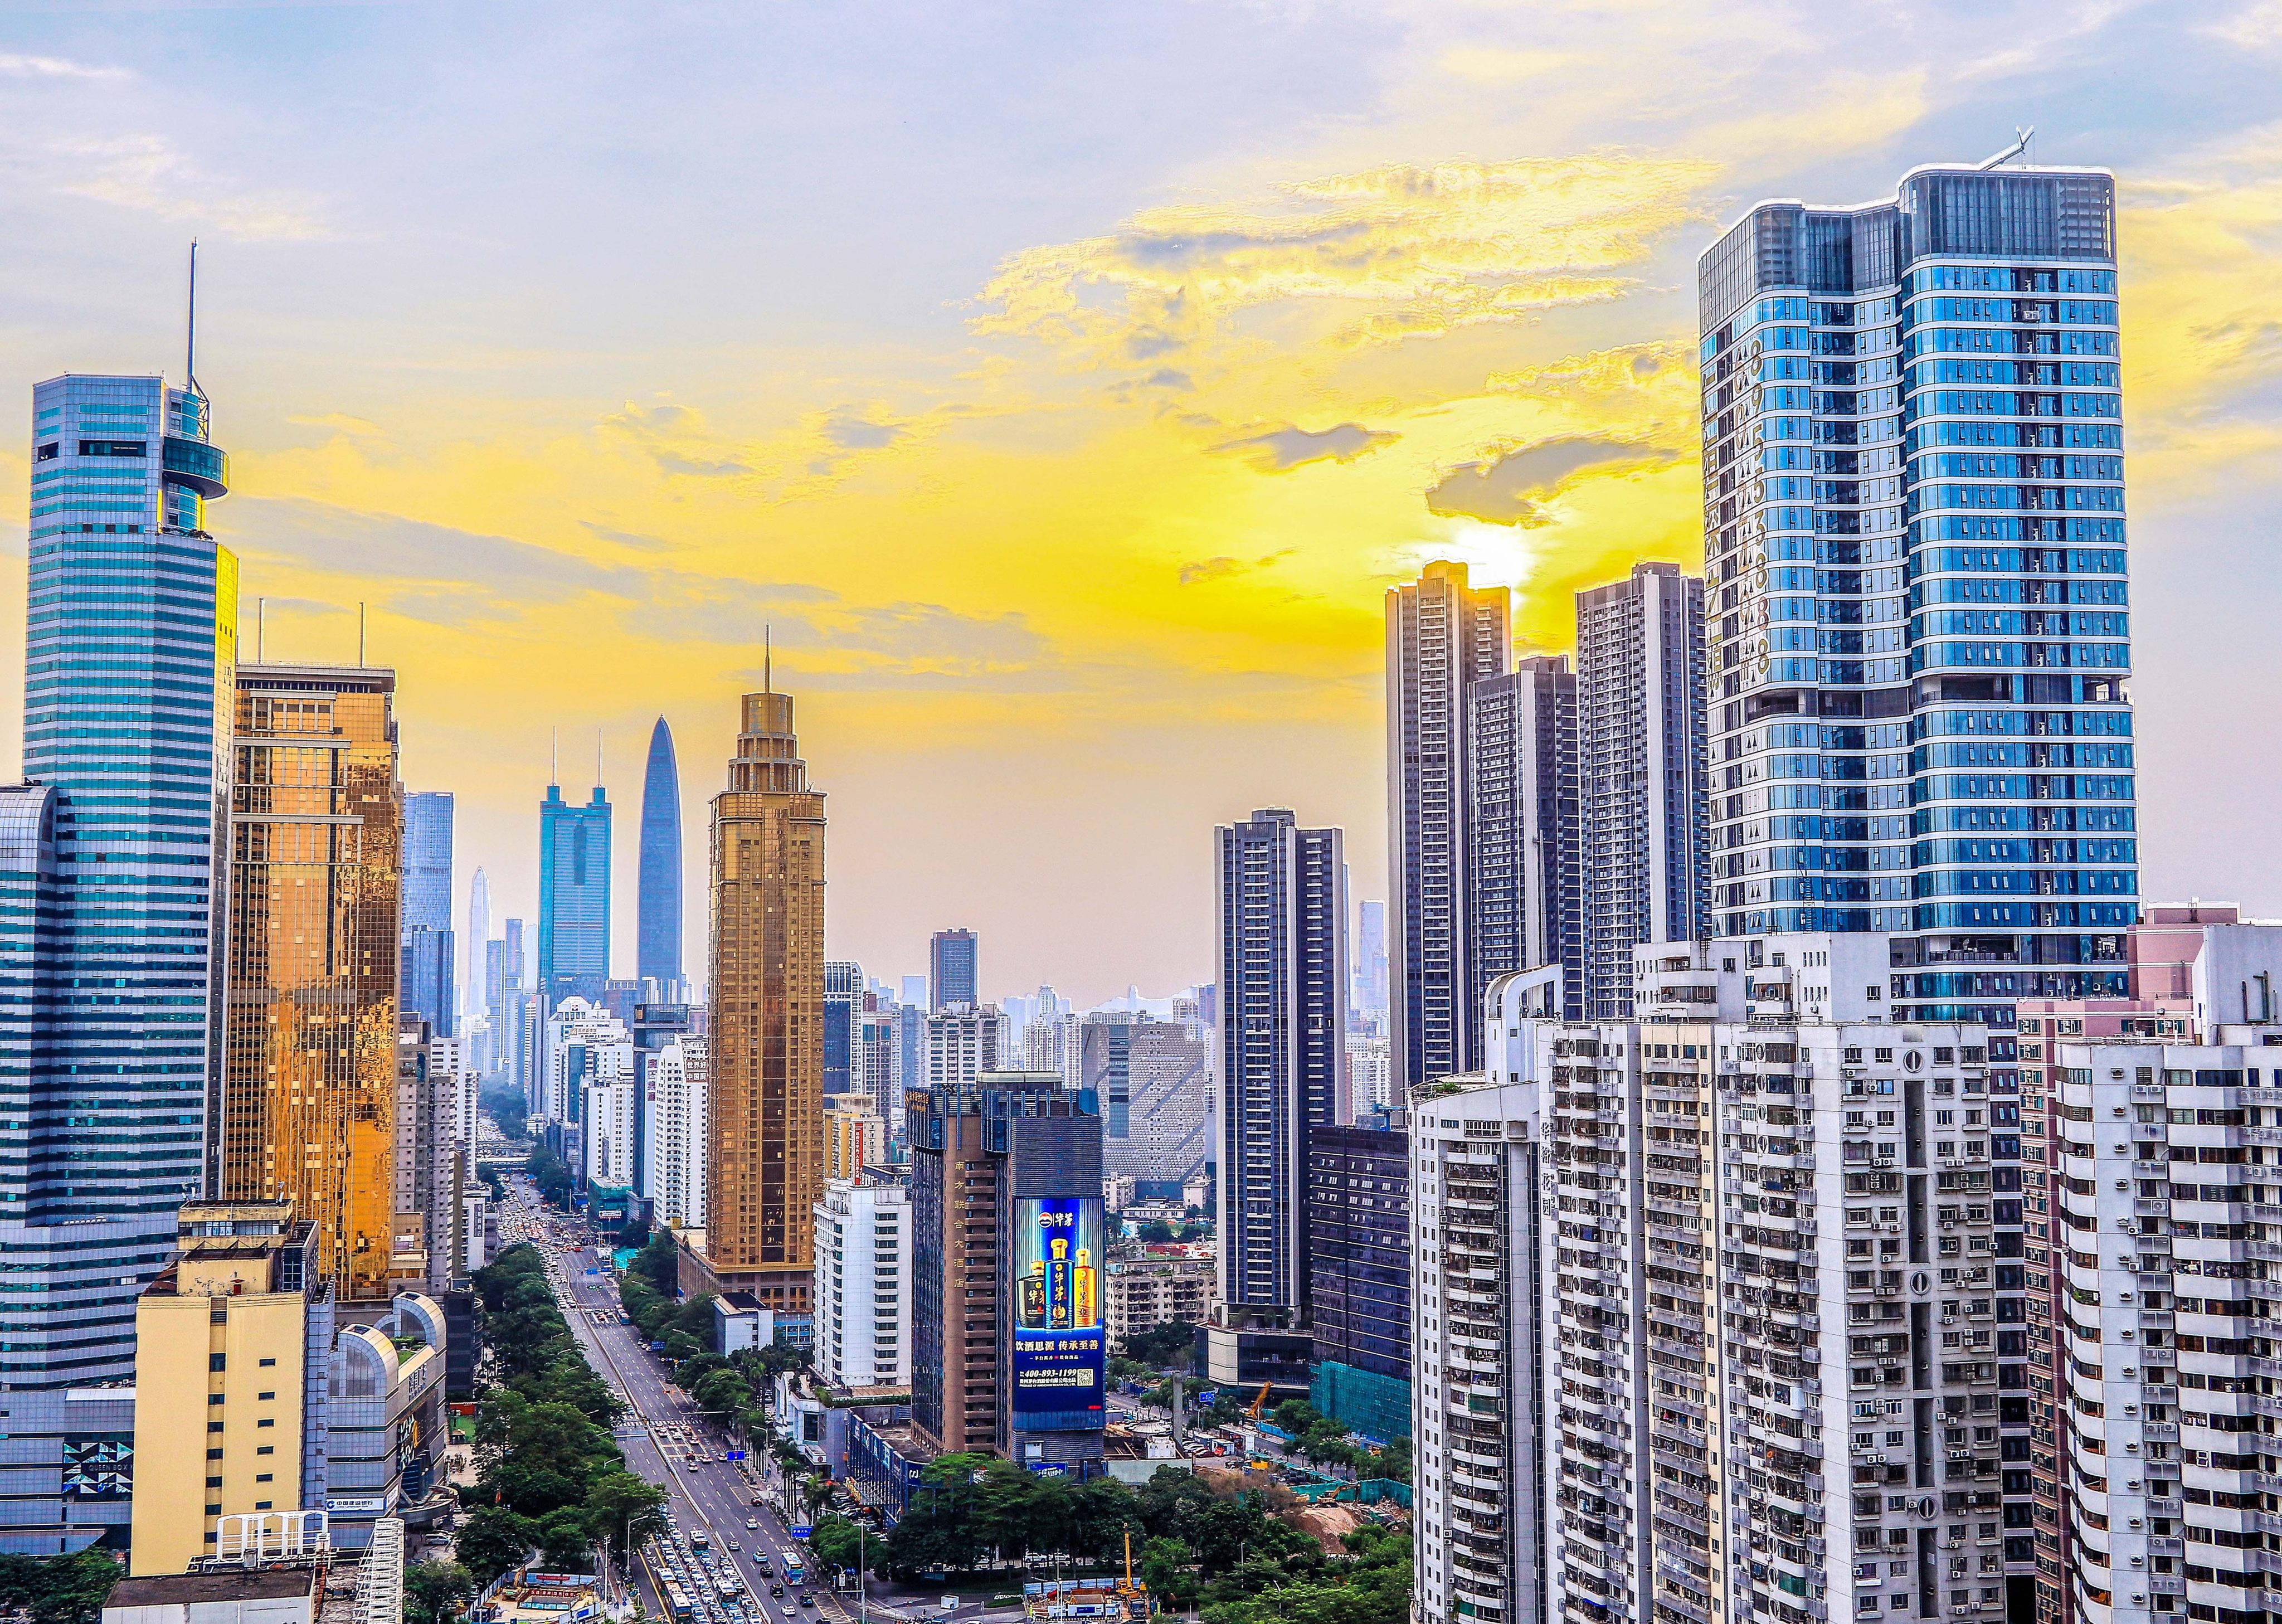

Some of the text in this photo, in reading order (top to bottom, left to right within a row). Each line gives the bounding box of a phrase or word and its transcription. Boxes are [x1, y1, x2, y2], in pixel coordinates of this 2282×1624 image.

[953, 1161, 965, 1288] 南方联合大酒店
[1015, 1340, 1098, 1351] 饮酒思源 传承至善
[1025, 1369, 1077, 1378] 400-893-1199
